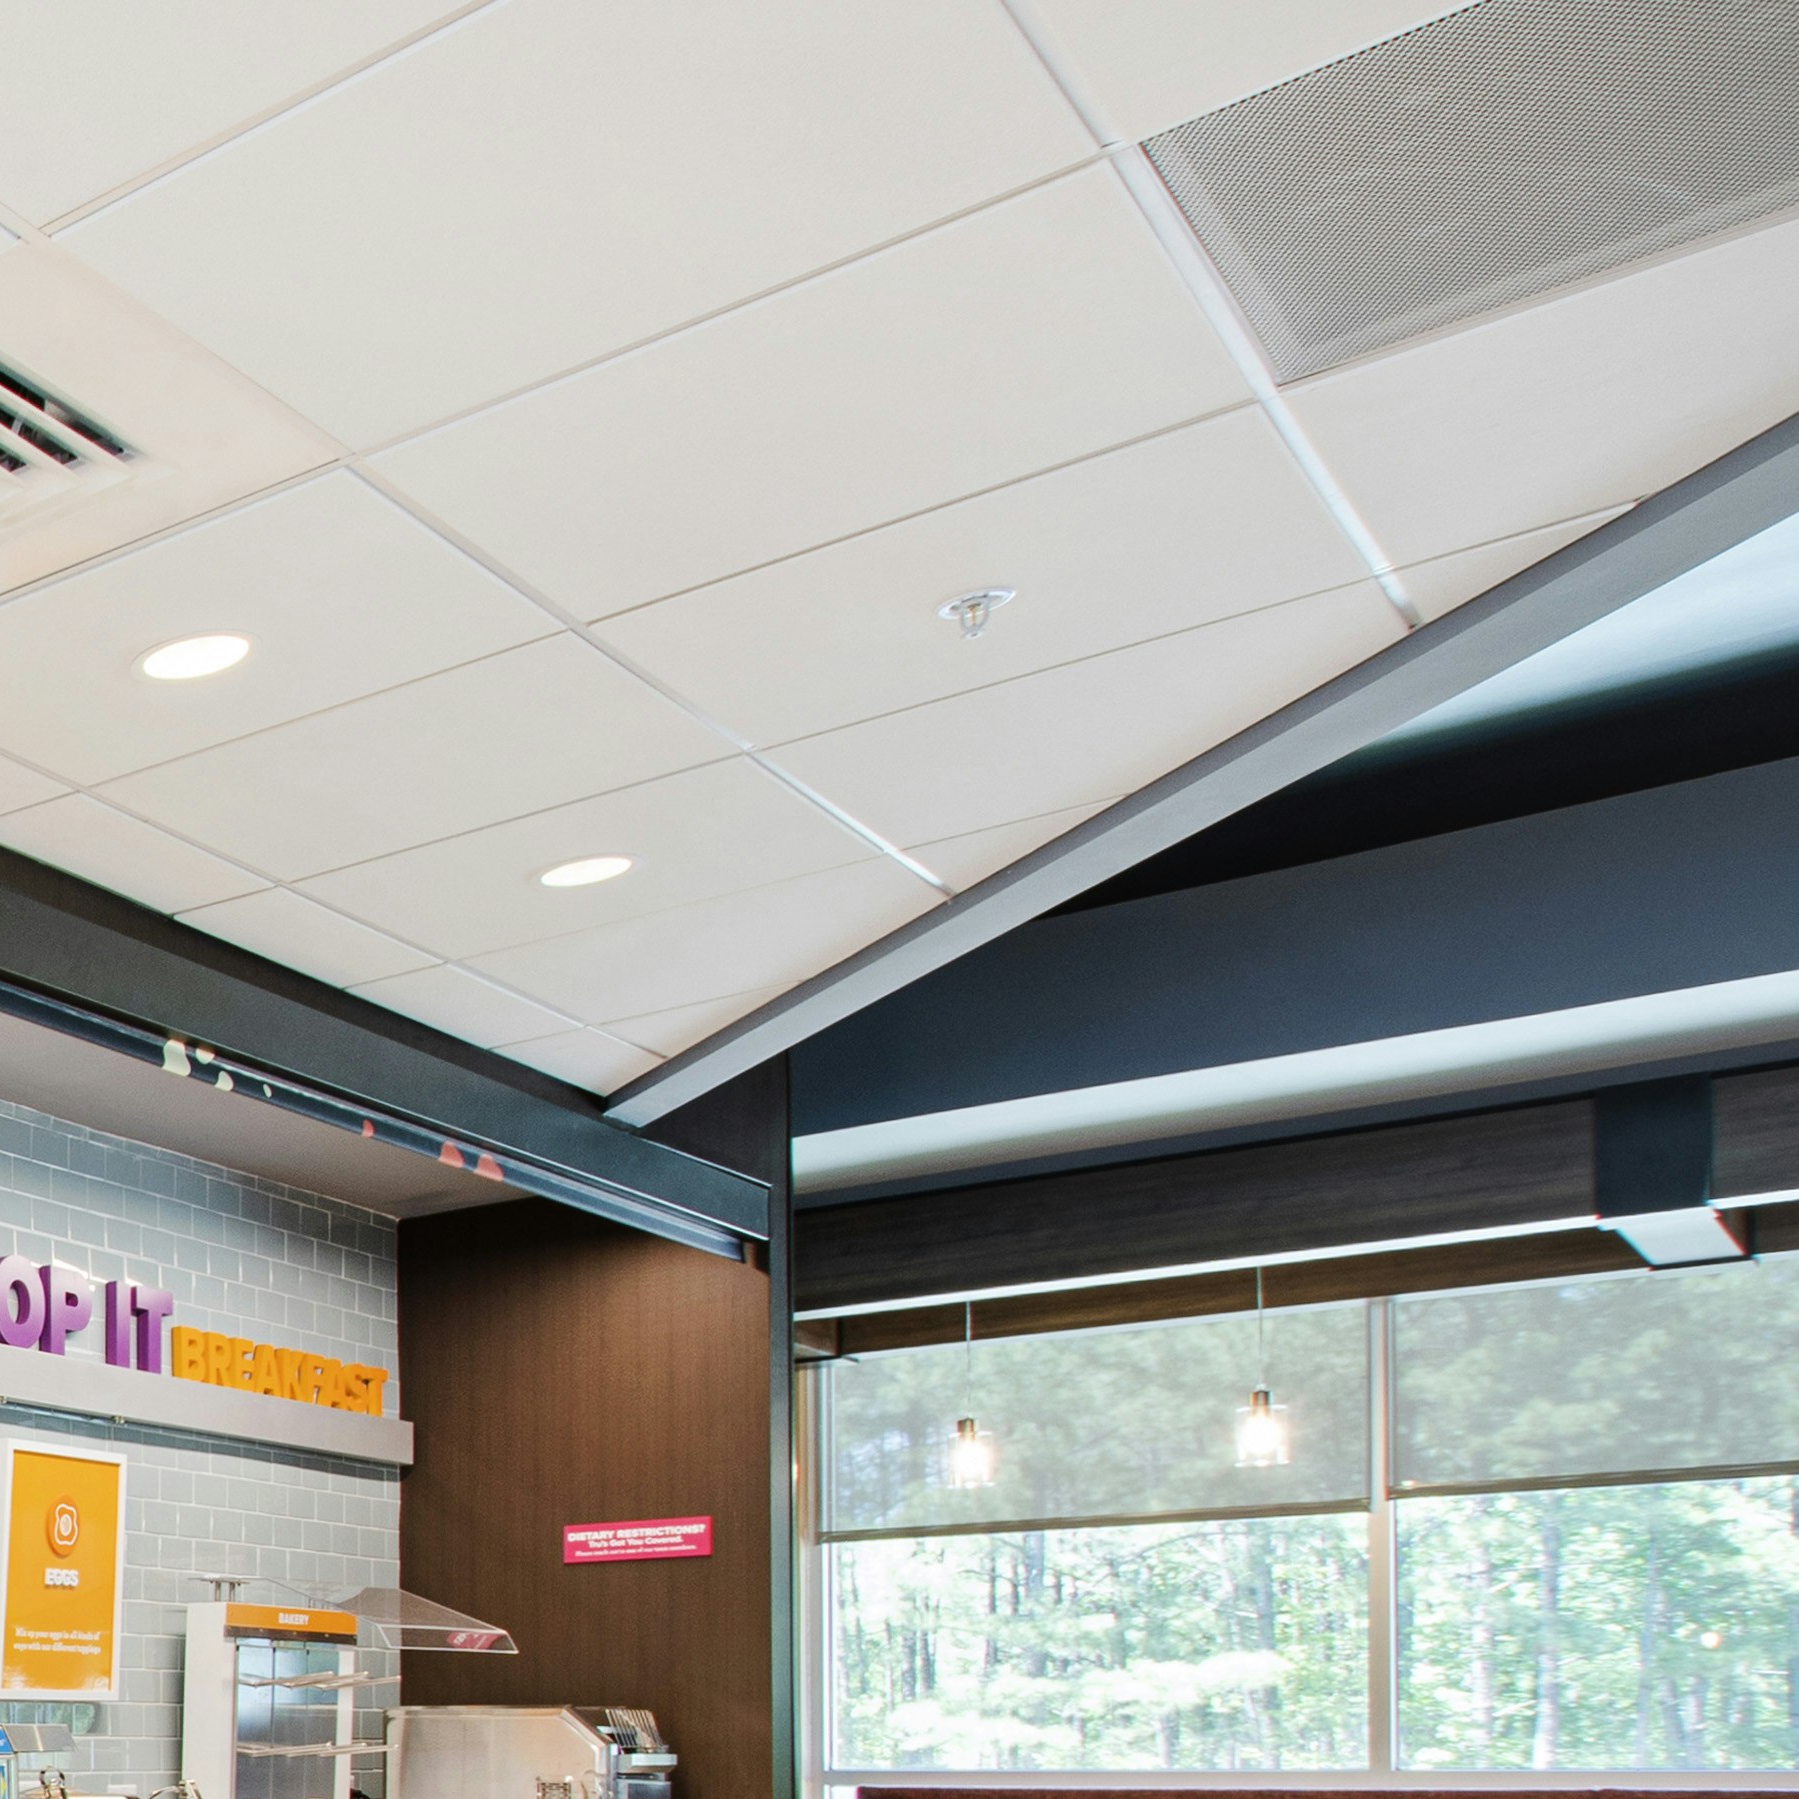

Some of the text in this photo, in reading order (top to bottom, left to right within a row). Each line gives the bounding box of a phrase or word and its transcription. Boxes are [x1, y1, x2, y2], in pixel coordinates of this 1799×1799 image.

[105, 1280, 173, 1374] IT
[171, 1326, 388, 1418] BREAKFAST
[567, 1524, 706, 1542] DIETARY RESTRICTIONS?
[609, 1539, 626, 1547] Got
[627, 1538, 644, 1546] You
[44, 1567, 80, 1587] EGGS
[278, 1612, 310, 1625] BAKERY
